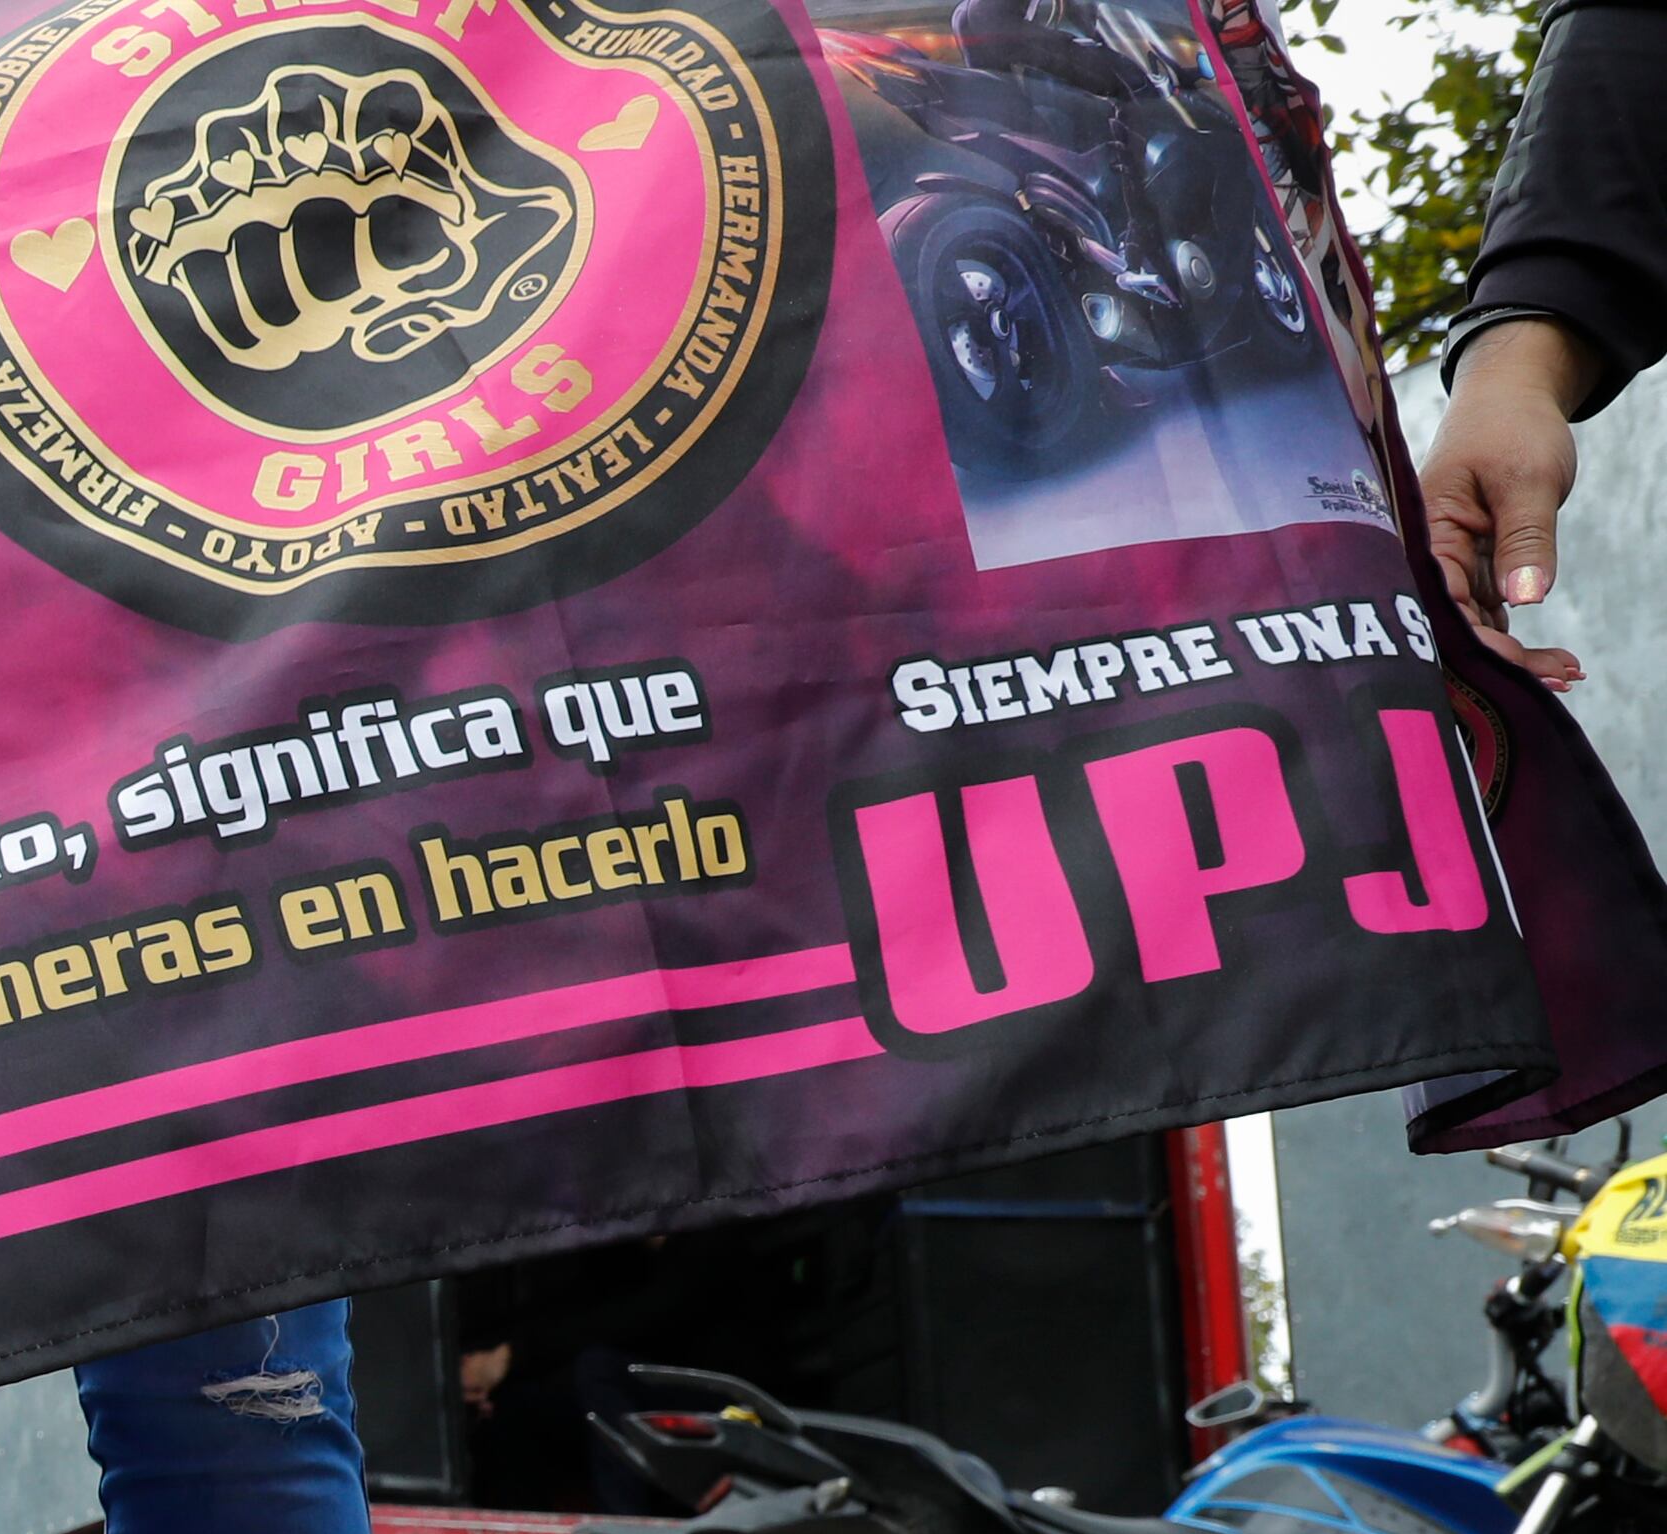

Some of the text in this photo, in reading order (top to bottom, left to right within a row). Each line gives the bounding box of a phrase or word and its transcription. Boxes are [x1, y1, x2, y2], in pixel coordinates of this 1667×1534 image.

[564, 20, 739, 113] HUMILDAD
[662, 153, 762, 400] HERMANDA
[250, 343, 594, 512] GIRLS
[440, 418, 656, 536] LEALTAD
[201, 511, 385, 575] APOYO
[891, 624, 1234, 733] SIEMPRE
[116, 698, 524, 839] significa
[543, 670, 704, 763] que
[281, 872, 406, 950] en
[420, 798, 747, 921] hacerlo
